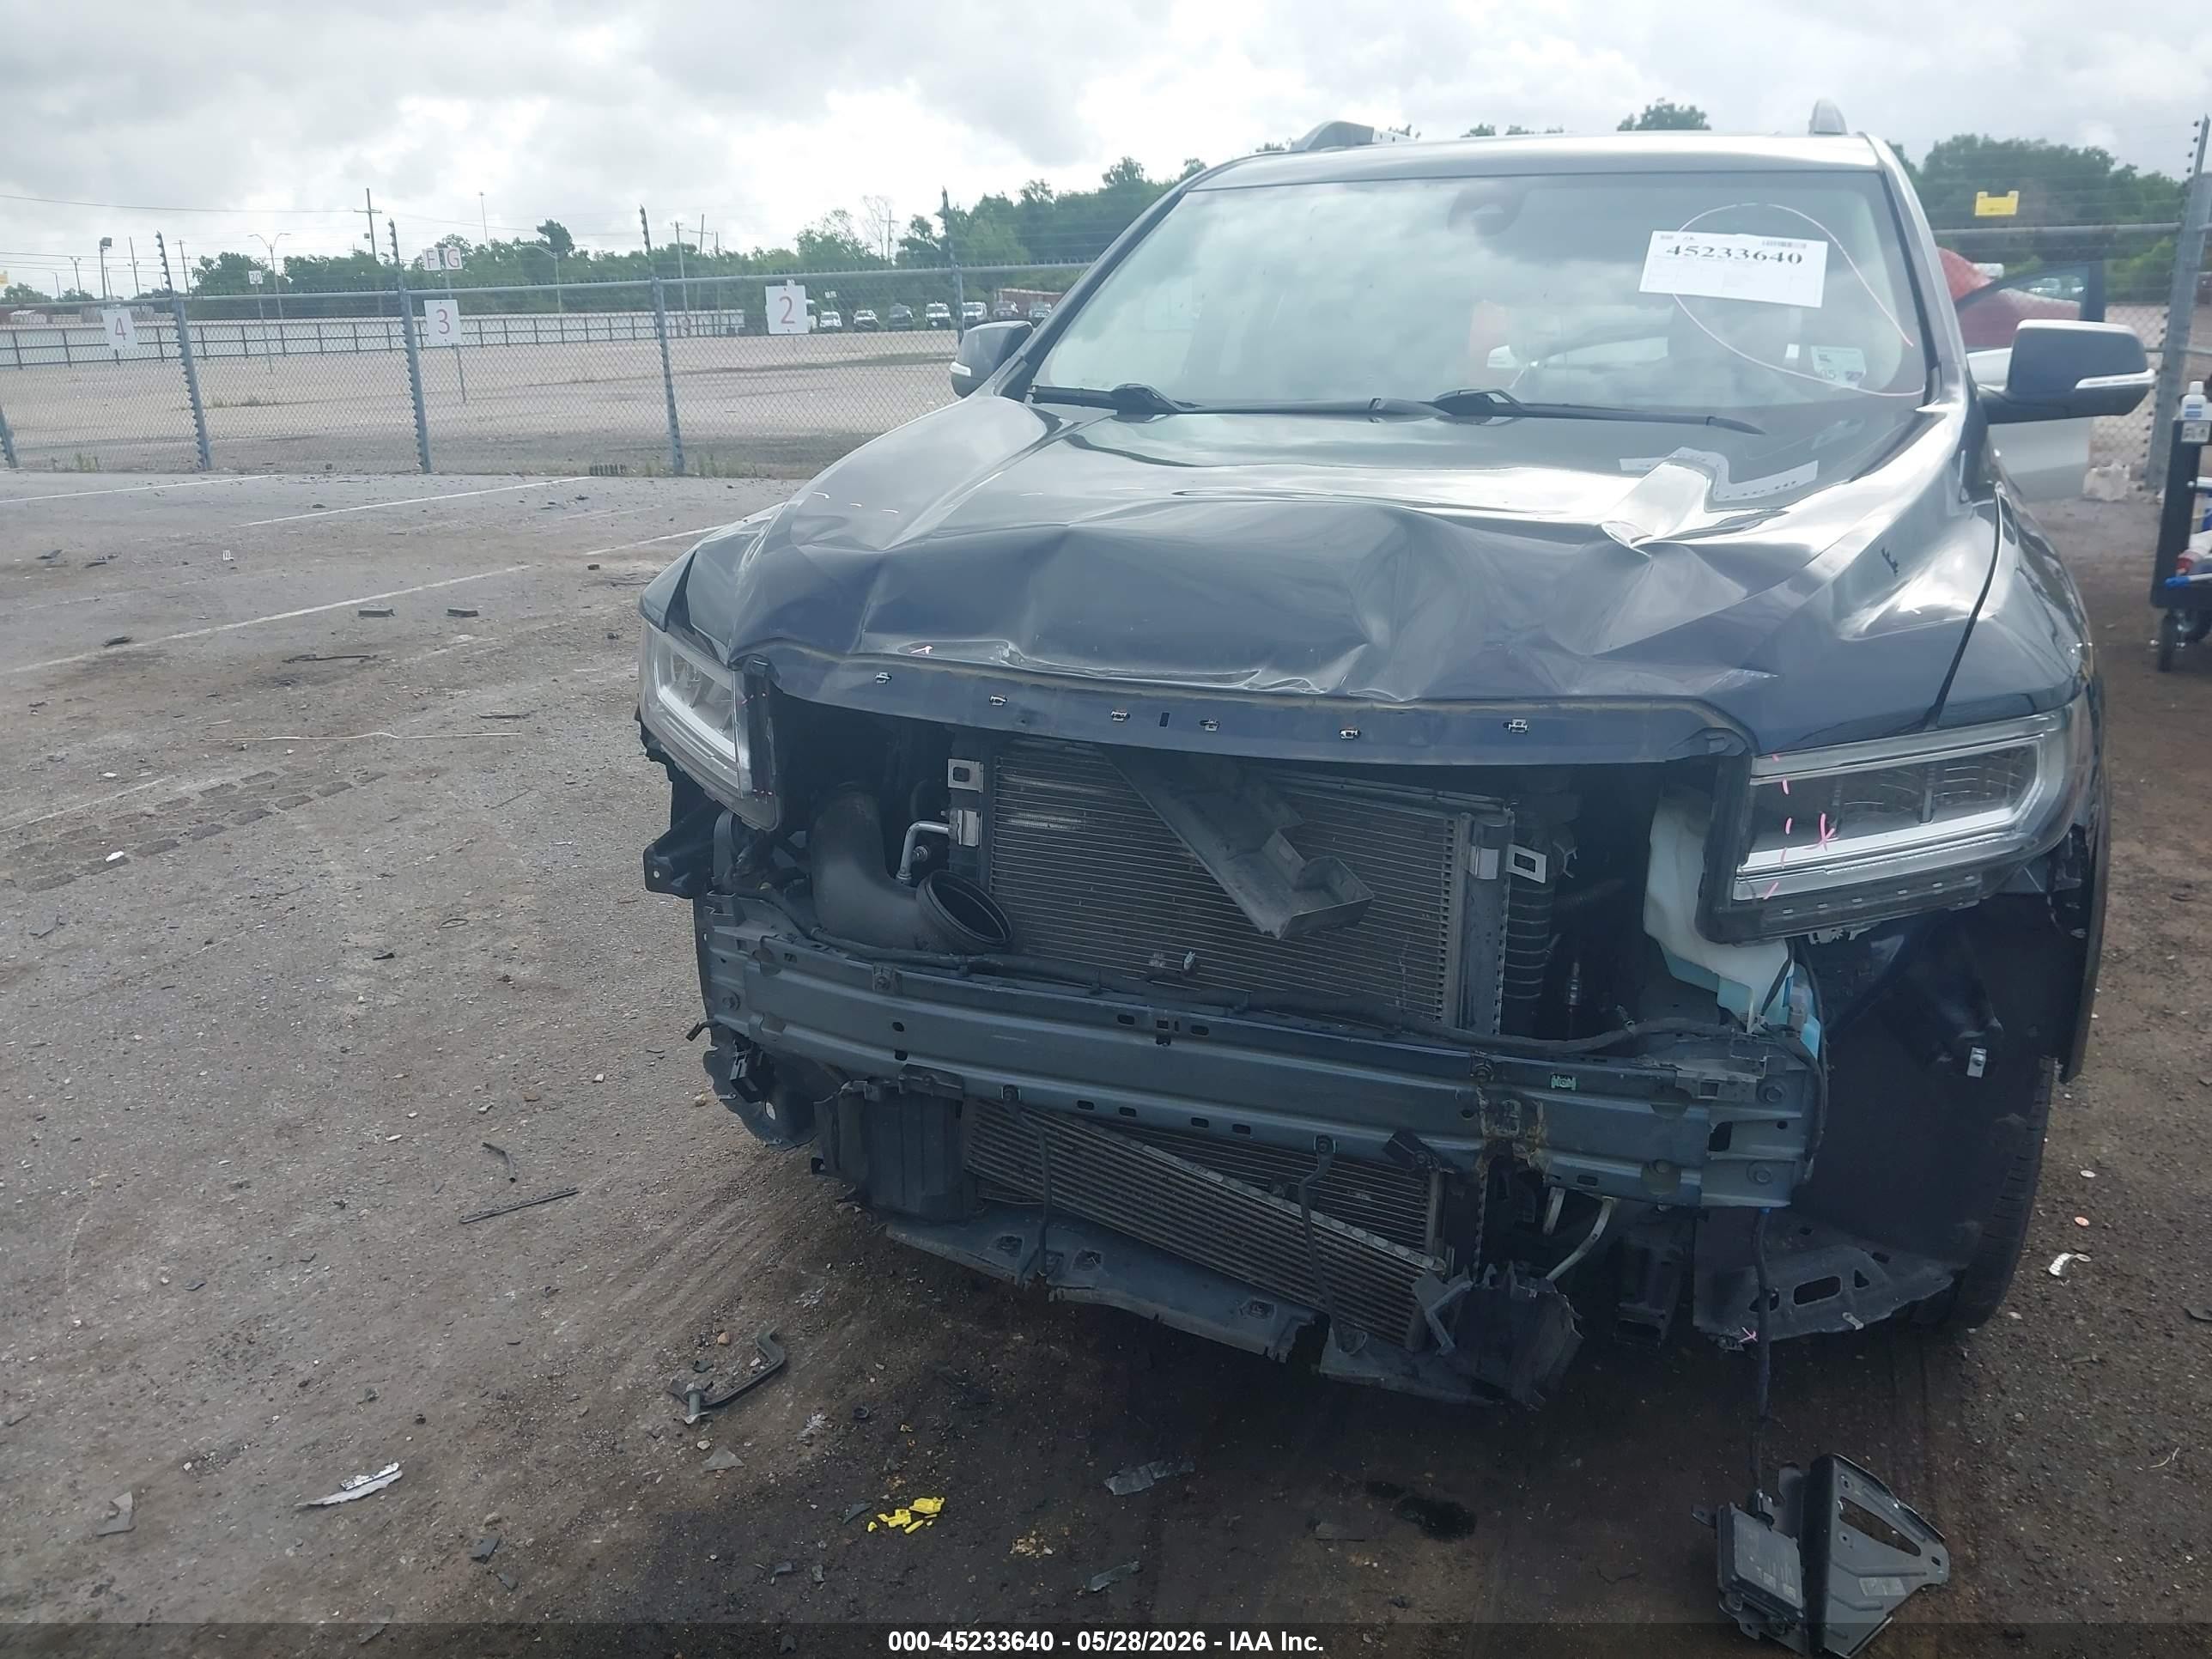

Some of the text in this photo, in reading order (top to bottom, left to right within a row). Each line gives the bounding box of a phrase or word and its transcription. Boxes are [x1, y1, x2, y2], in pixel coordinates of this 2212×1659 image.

[426, 249, 435, 269] F
[447, 248, 460, 268] G
[1666, 244, 1802, 265] 45233640
[779, 295, 796, 324] 2
[114, 317, 127, 341] 4
[434, 308, 451, 335] 3
